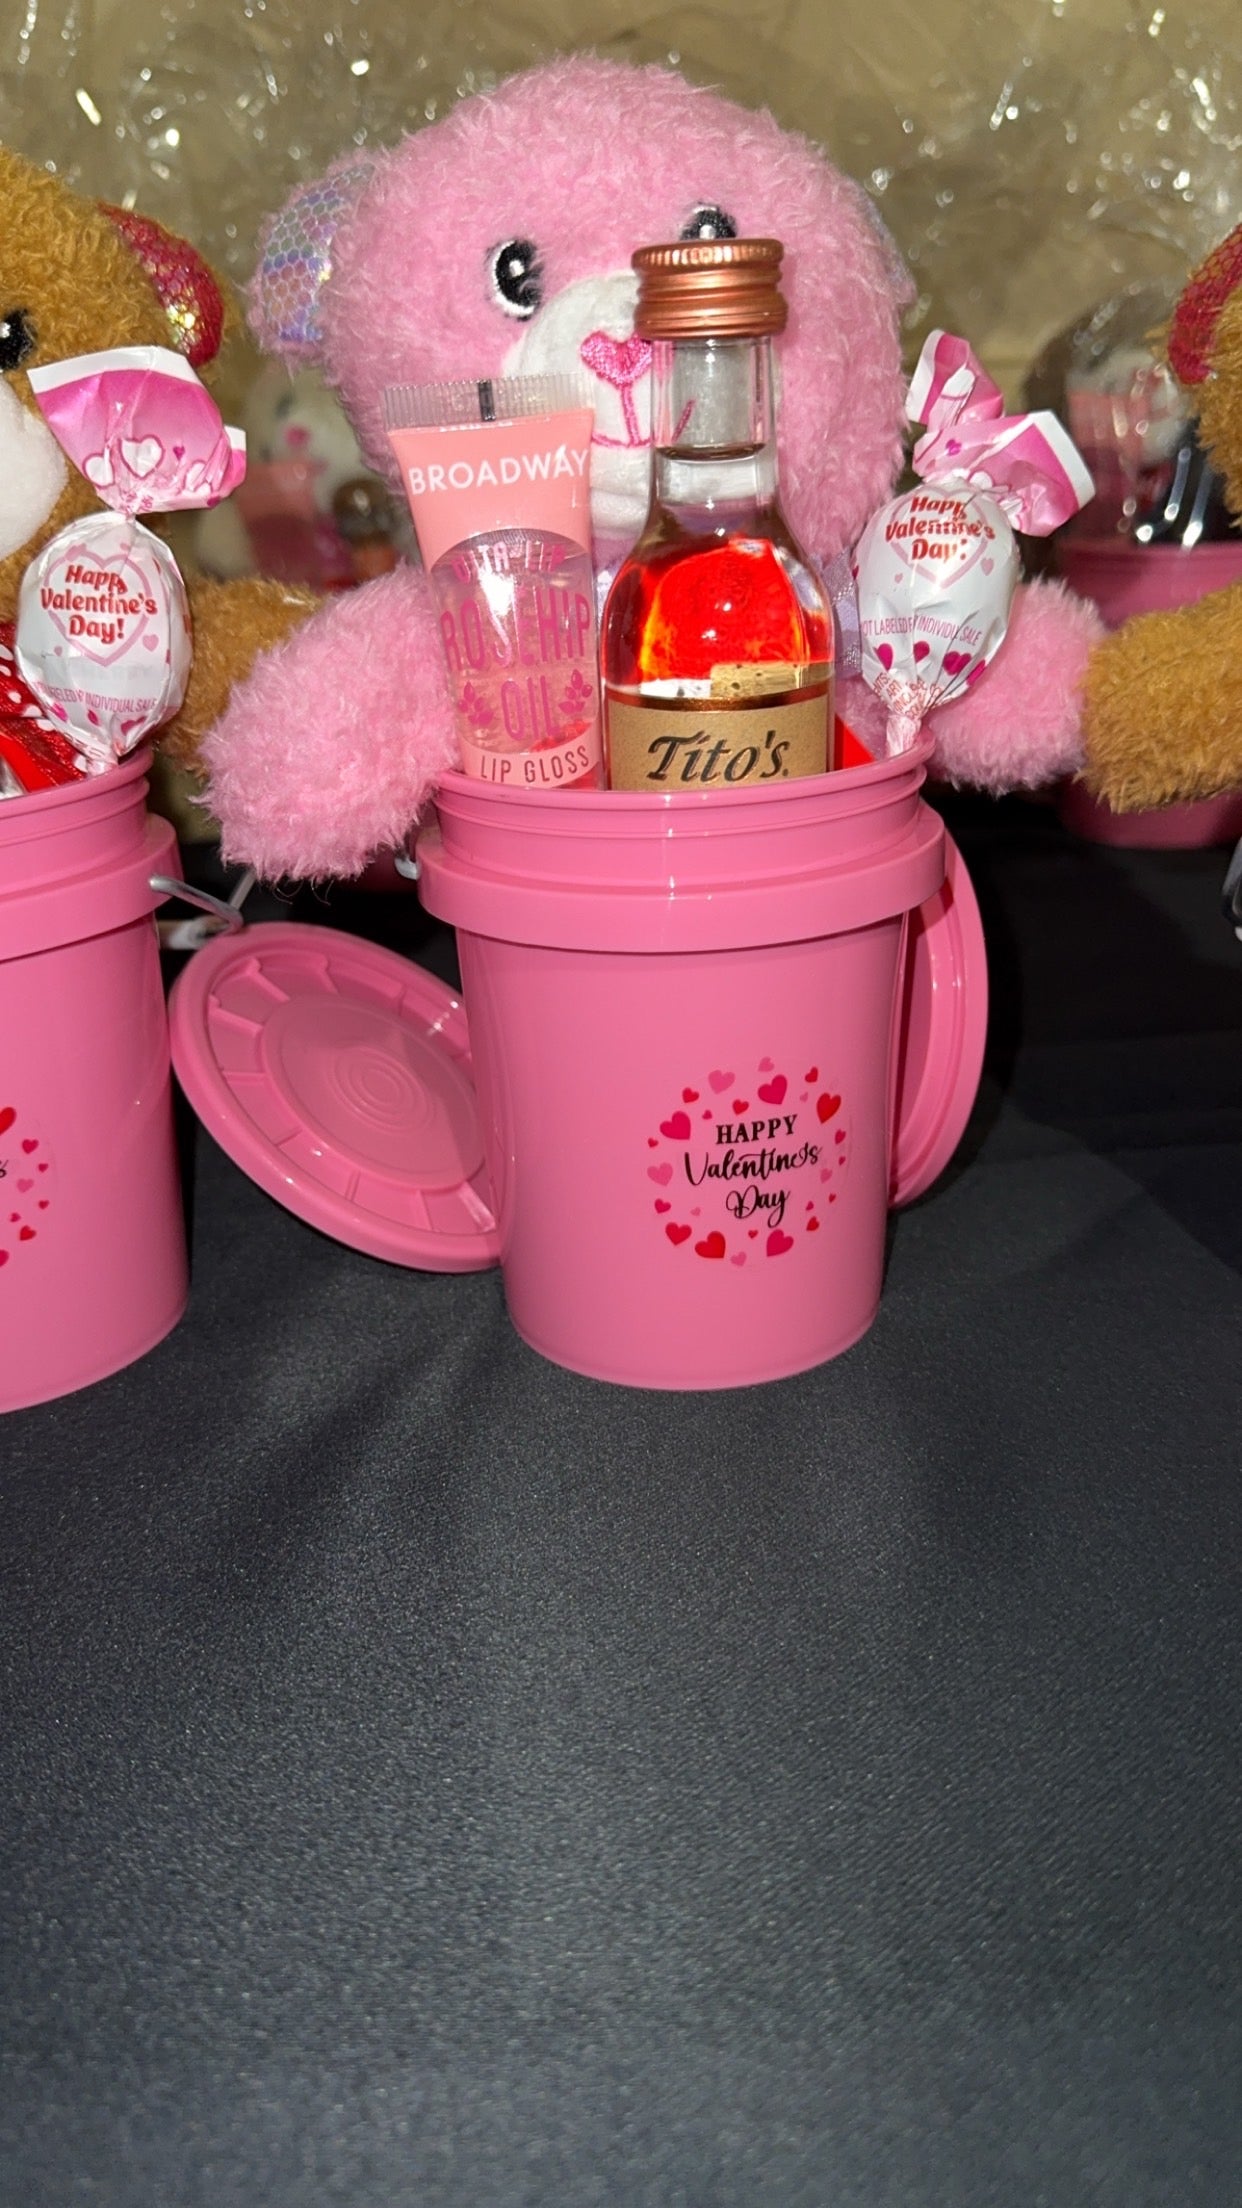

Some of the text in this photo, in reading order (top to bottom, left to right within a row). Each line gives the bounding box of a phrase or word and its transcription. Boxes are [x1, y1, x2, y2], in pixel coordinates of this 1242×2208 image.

[408, 447, 589, 496] BROADWAY
[40, 587, 157, 615] Valentine's
[69, 614, 124, 644] Day!
[501, 674, 561, 741] OIL
[480, 745, 590, 783] LIP GLOSS
[715, 1113, 798, 1145] HAPPY
[725, 1184, 791, 1229] Day
